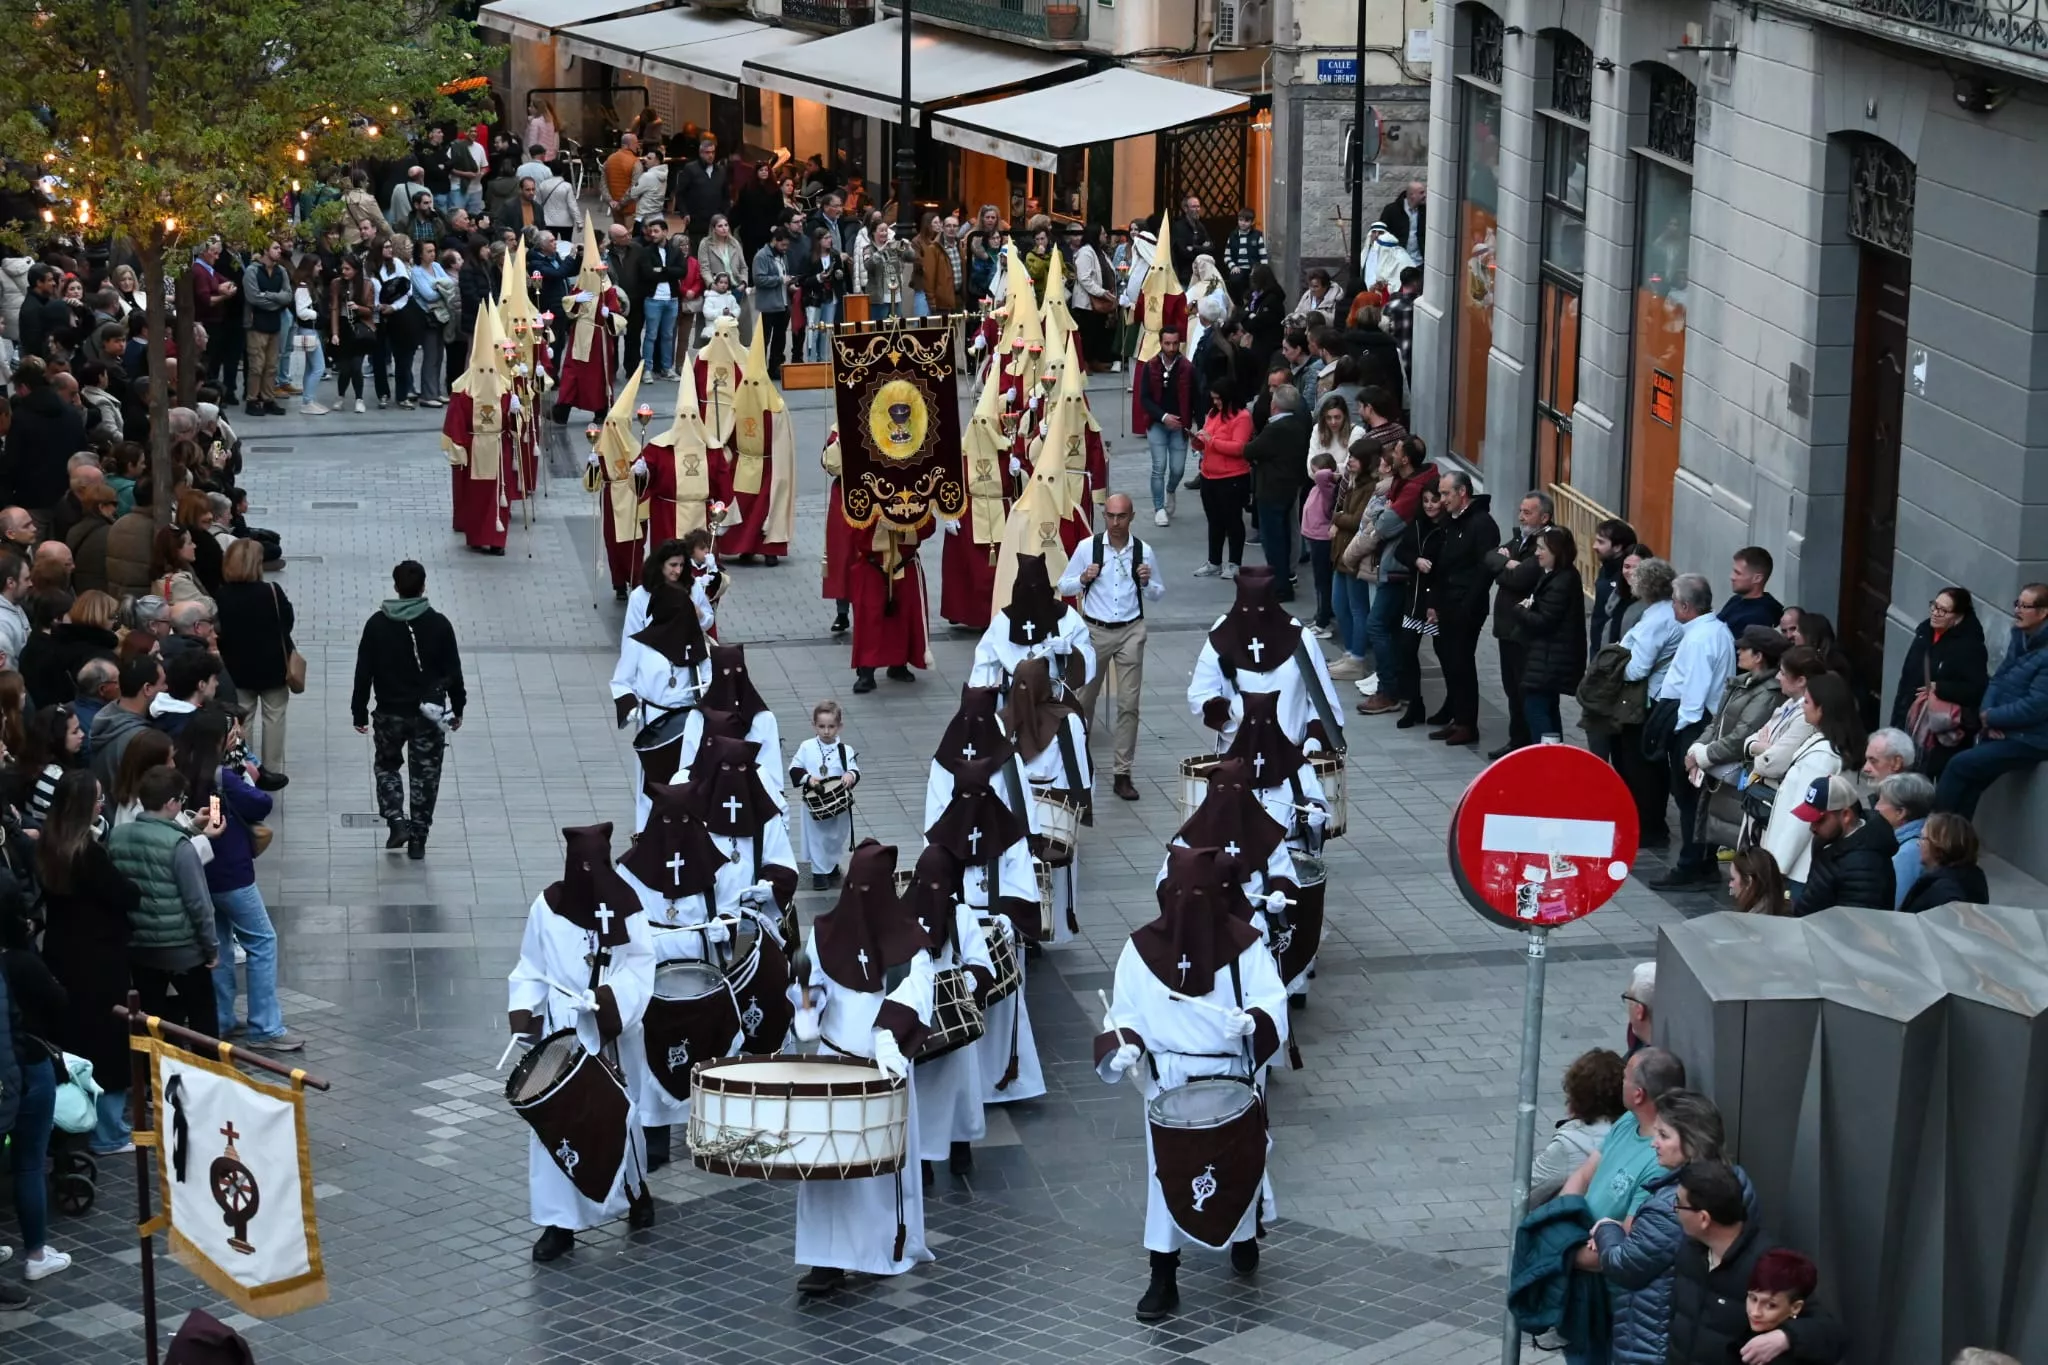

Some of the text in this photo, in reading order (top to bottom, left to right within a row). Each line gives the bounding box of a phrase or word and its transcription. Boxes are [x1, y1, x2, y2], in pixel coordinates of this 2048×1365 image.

[1328, 61, 1352, 69] CALLE
[1319, 74, 1357, 84] SAN ORENCI
